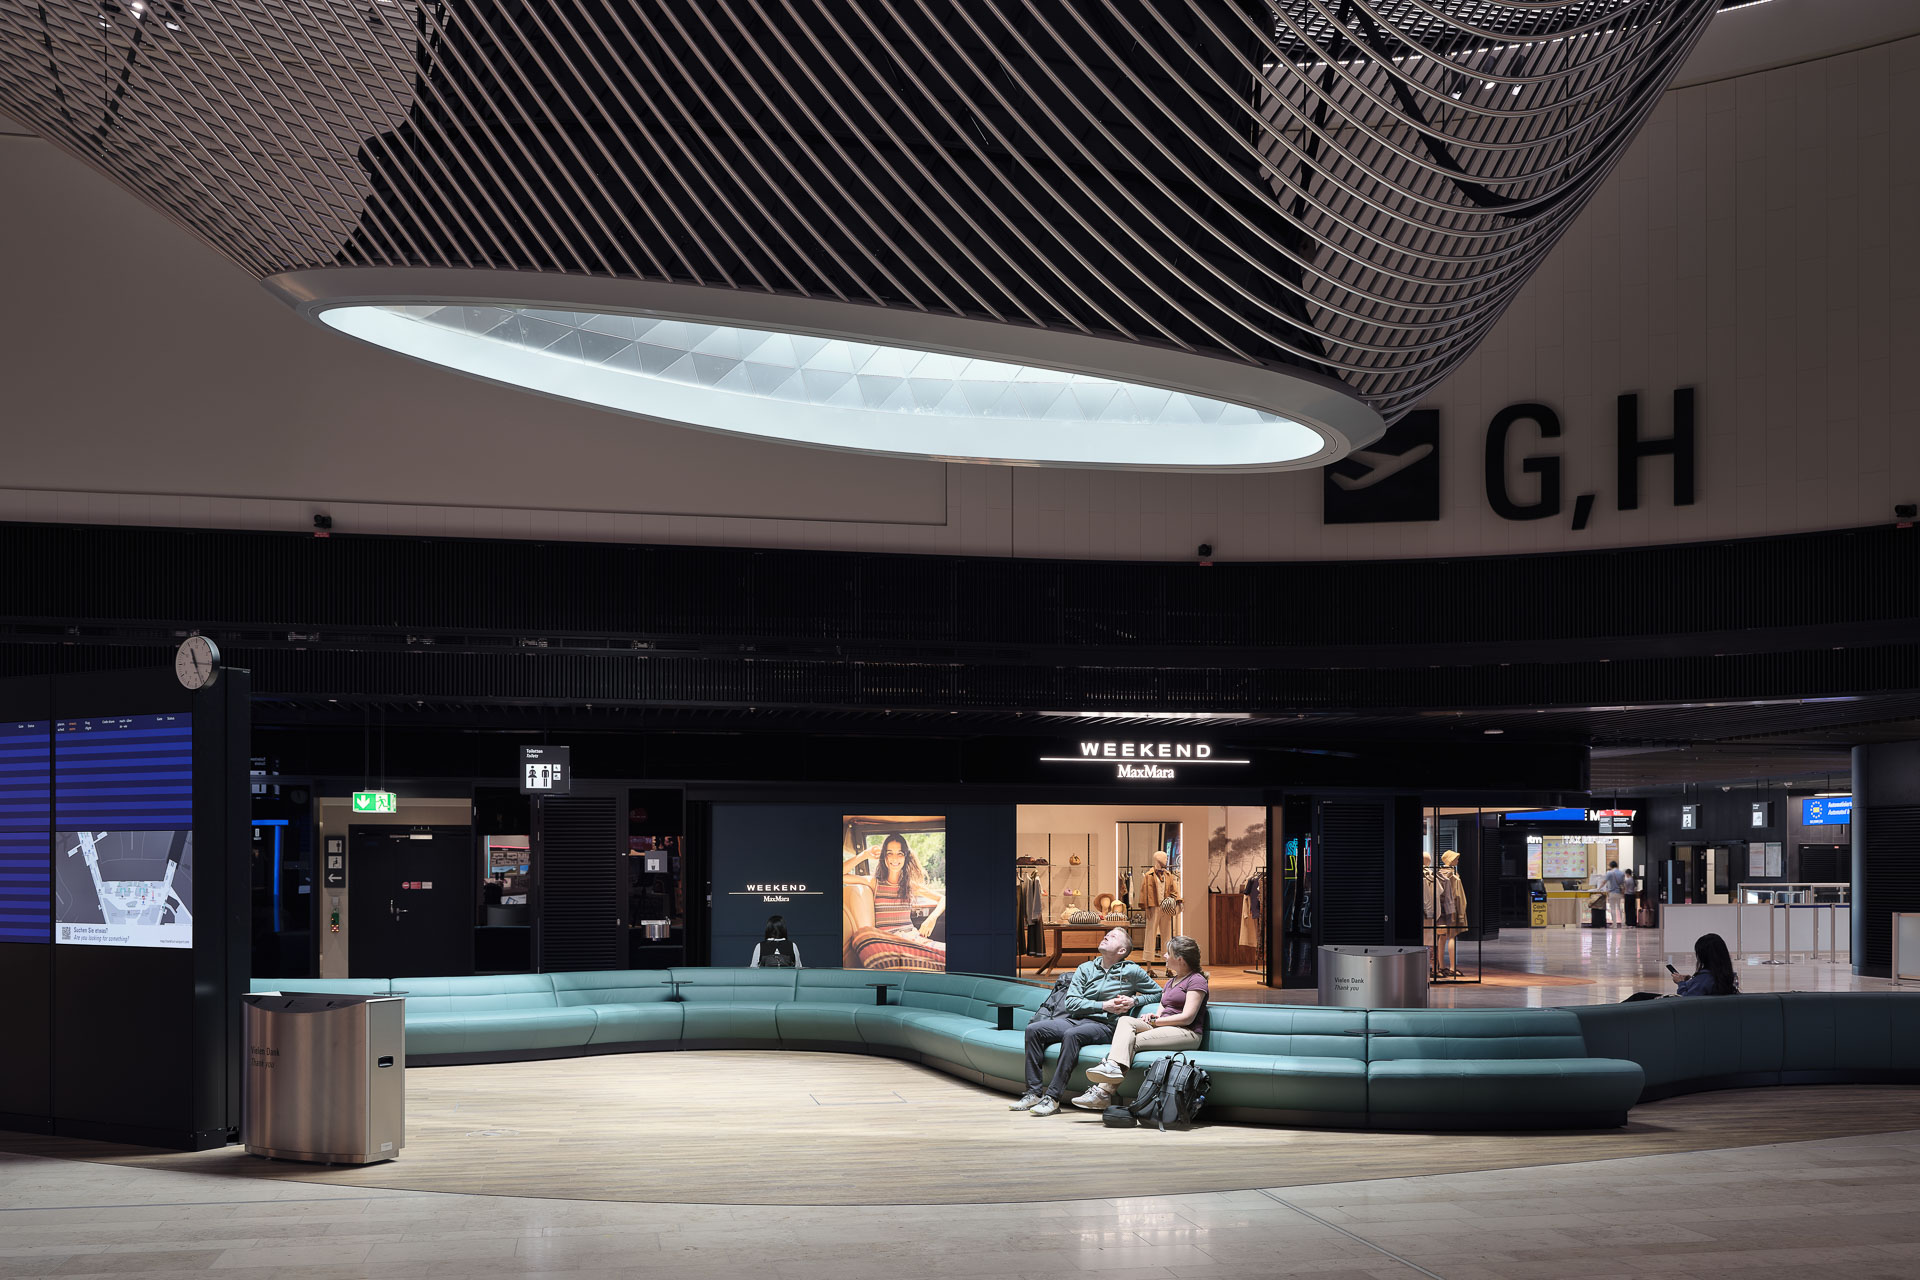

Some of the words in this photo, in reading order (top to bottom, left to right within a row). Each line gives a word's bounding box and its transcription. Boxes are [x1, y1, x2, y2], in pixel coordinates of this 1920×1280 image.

[1080, 742, 1211, 758] WEEKEND
[1117, 764, 1175, 778] MaxMara
[1564, 835, 1581, 844] TAX
[250, 1046, 266, 1055] Vielen
[266, 1047, 280, 1056] Dank
[251, 1058, 264, 1067] Thank
